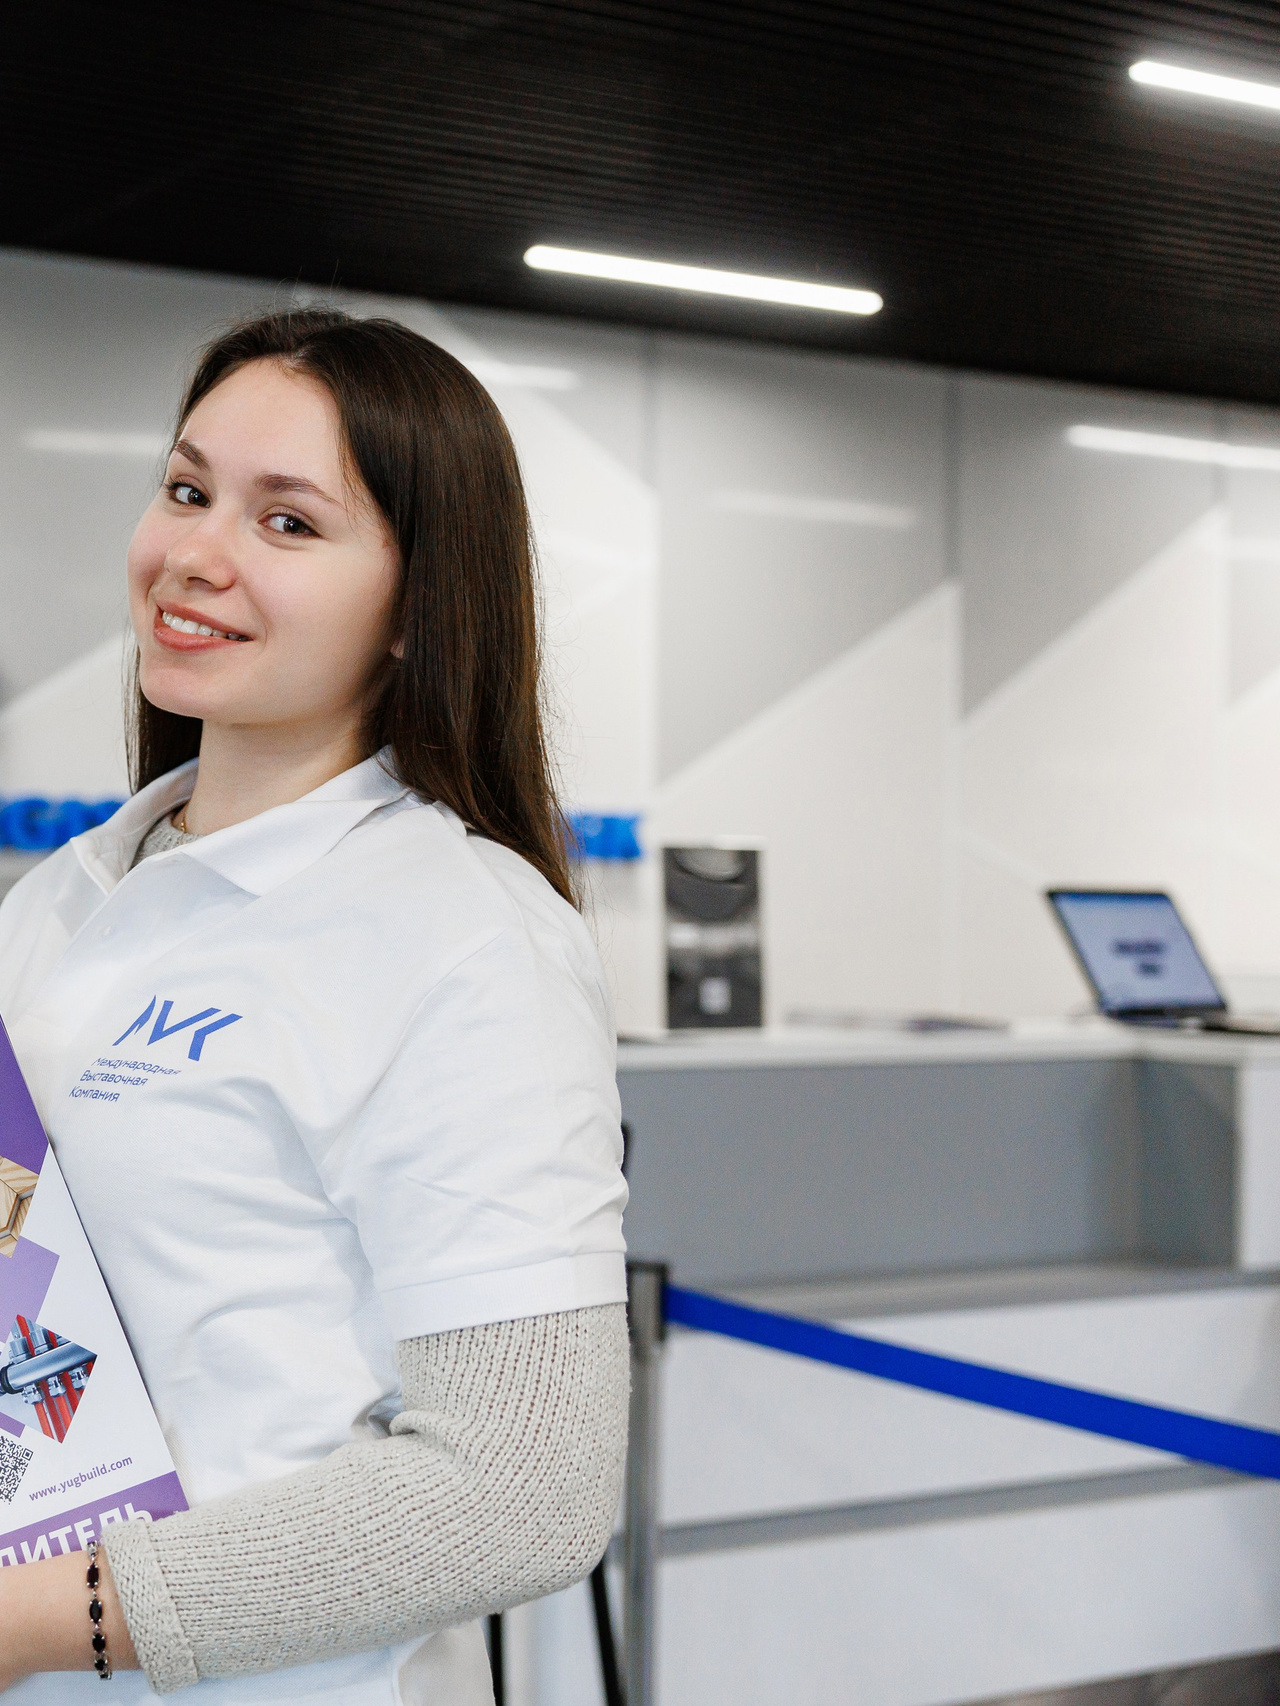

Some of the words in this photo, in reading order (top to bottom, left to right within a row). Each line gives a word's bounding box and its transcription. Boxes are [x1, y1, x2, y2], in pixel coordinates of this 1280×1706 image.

[92, 1057, 181, 1076] Международная
[80, 1069, 148, 1086] Выставочная
[69, 1085, 120, 1102] Компания
[28, 1456, 133, 1501] www.yugbuild.com
